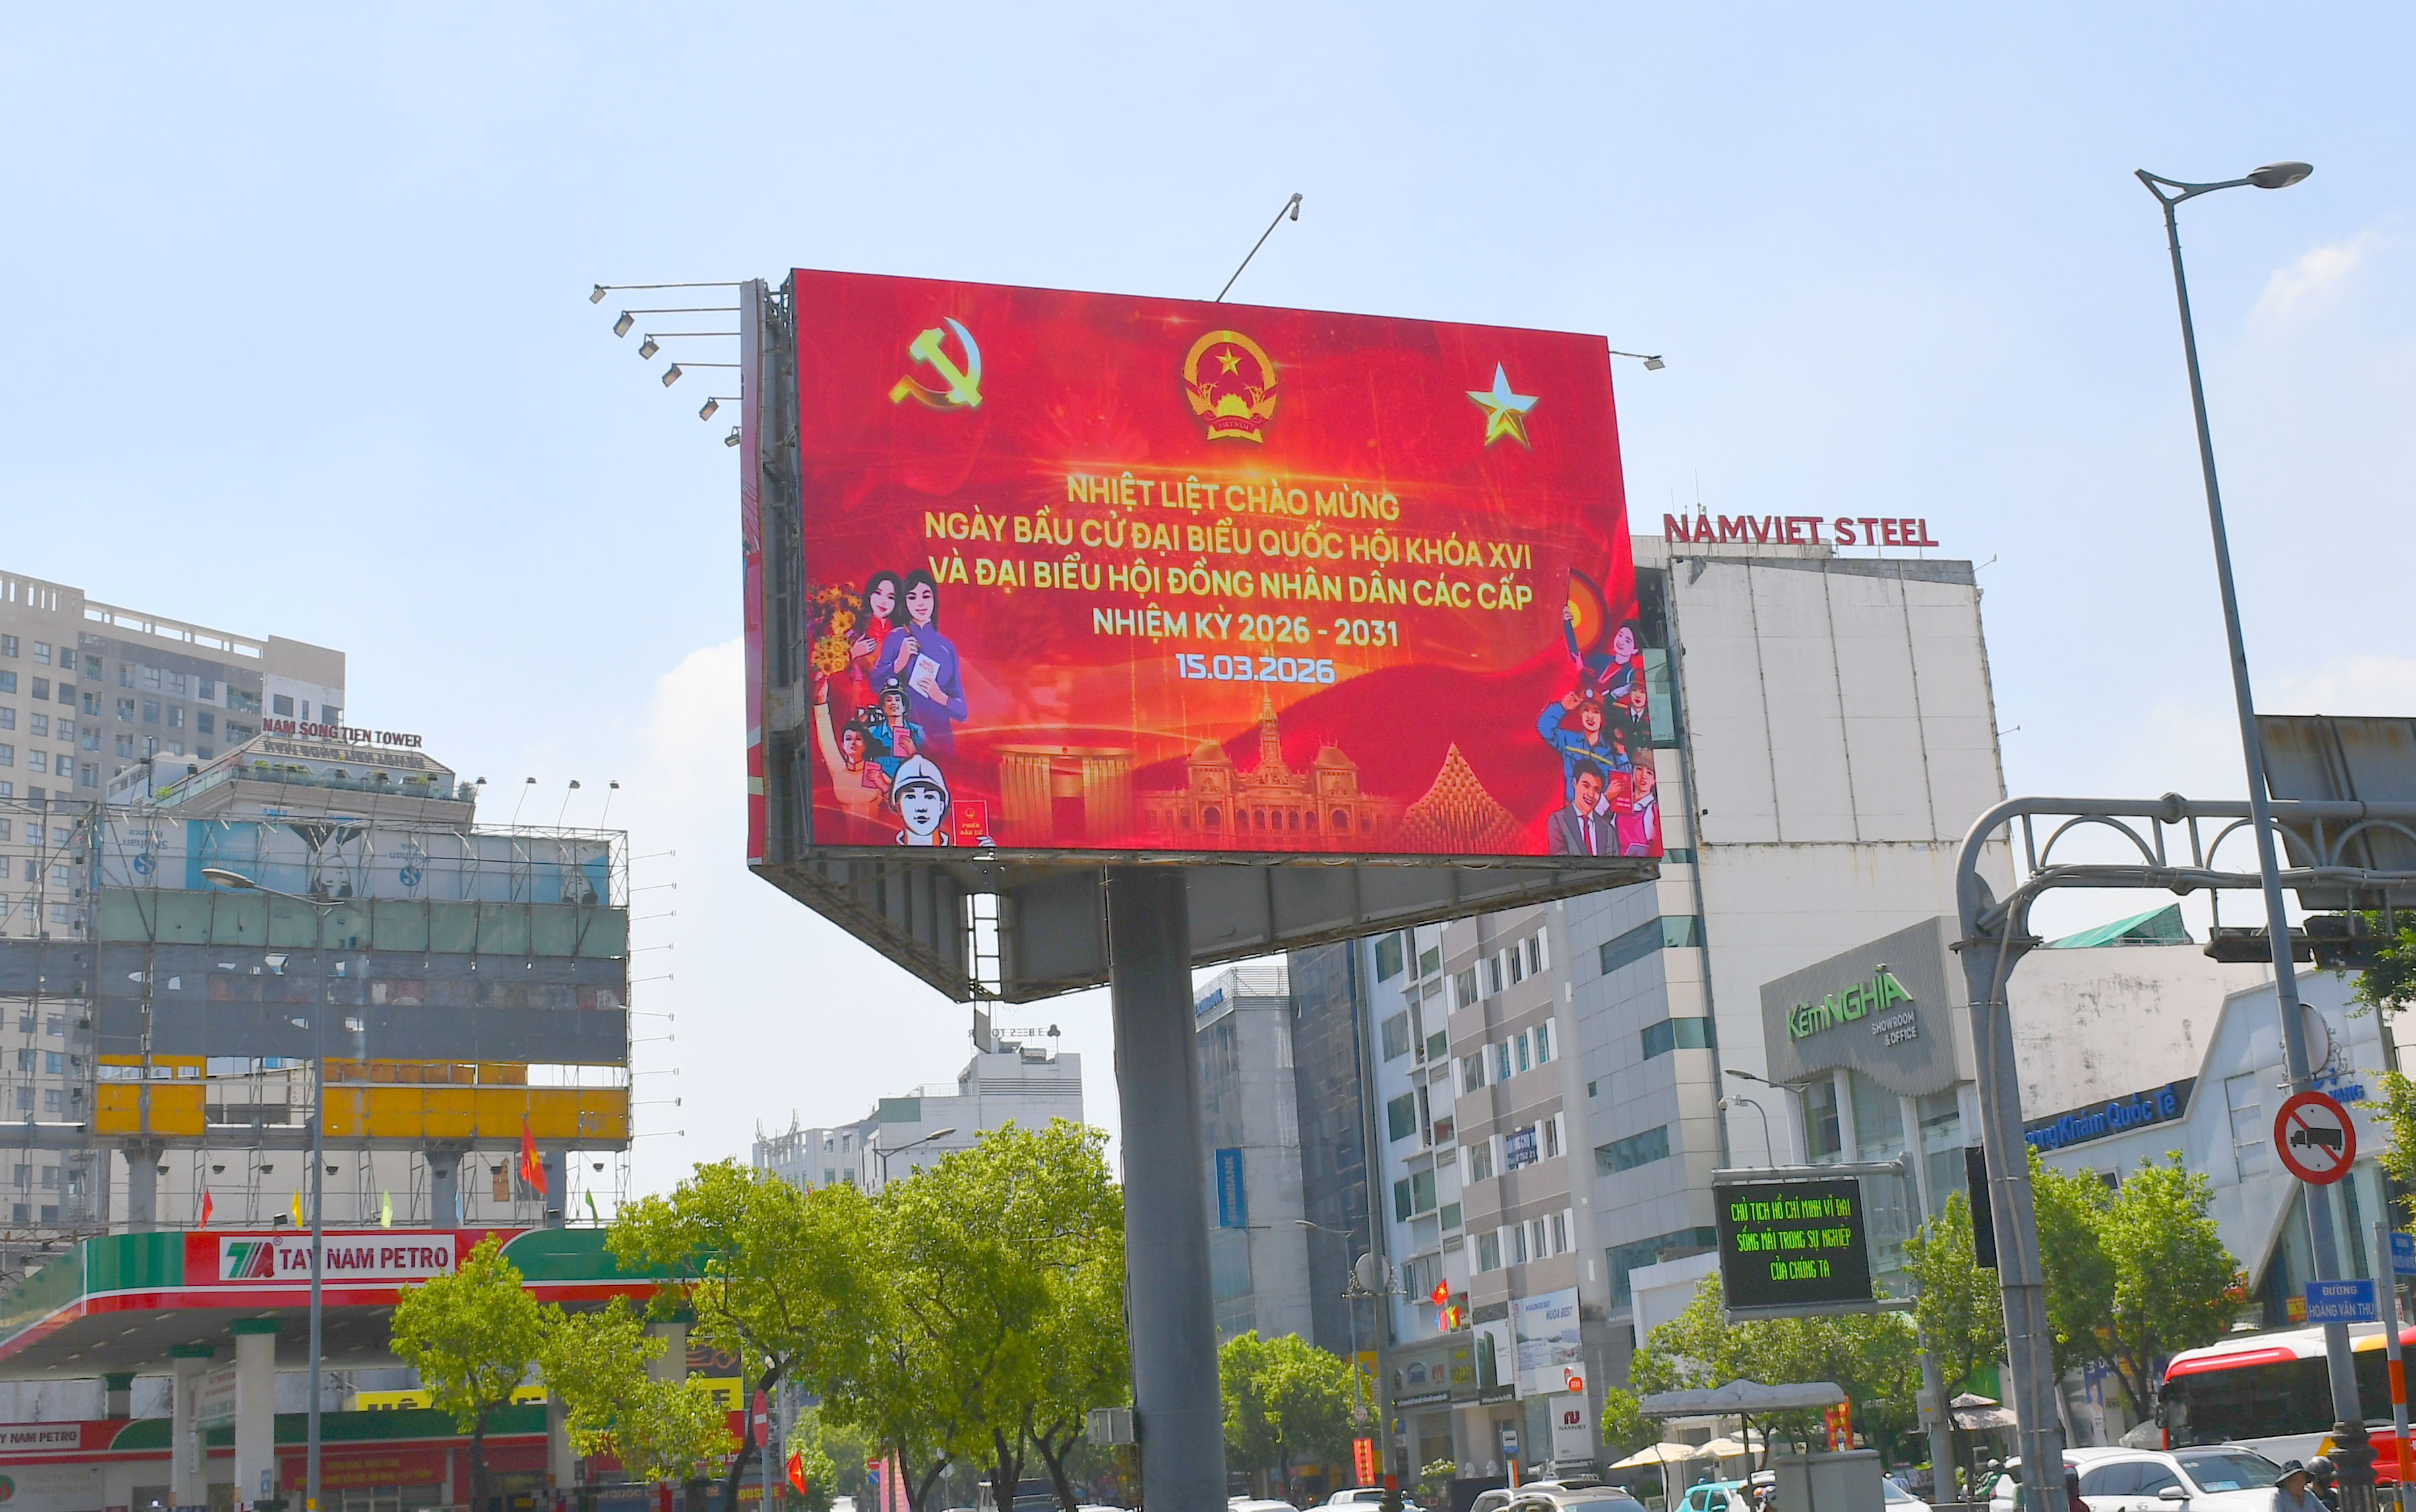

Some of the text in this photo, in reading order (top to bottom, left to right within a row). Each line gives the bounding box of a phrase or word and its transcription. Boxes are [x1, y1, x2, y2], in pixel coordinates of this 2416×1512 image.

[1067, 471, 1400, 521] NHIỆT LIỆT CHÀO MỪNG
[925, 504, 1532, 570] NGÀY BẦU CỬ ĐẠI BIỂU QUỐC HỘI KHÓA XVI
[1663, 513, 1939, 547] NAMVIET STEEL
[928, 547, 1533, 611] VÀ ĐẠI BIỂU HỘI ĐỒNG NHÂN DÂN CÁC CẤP
[1092, 601, 1188, 644] NHIỆM
[1194, 604, 1233, 640] KỲ
[1237, 614, 1311, 644] 2026
[1334, 619, 1398, 647] 2031
[1175, 653, 1336, 684] 15.03.2026
[263, 717, 423, 748] NAM SONG TIEN TOWER
[1871, 1009, 1915, 1036] SHOWROOM
[2107, 1092, 2152, 1128] Quốc
[2153, 1083, 2176, 1116] Tế
[1731, 1193, 1851, 1224] CHỦ TỊCH HỒ CHÍ MINH VĨ ĐẠI
[1737, 1223, 1851, 1252] SỐNG MÃI TRONG SỰ NGHIỆP
[327, 1248, 374, 1270] NAM
[381, 1246, 449, 1269] PETRO
[1770, 1255, 1831, 1281] CỦA CHÚNG TA
[2322, 1283, 2357, 1296] ĐƯỜNG
[2309, 1300, 2337, 1317] HOÀNG
[11, 1432, 37, 1443] NAM
[39, 1431, 77, 1442] PETRO
